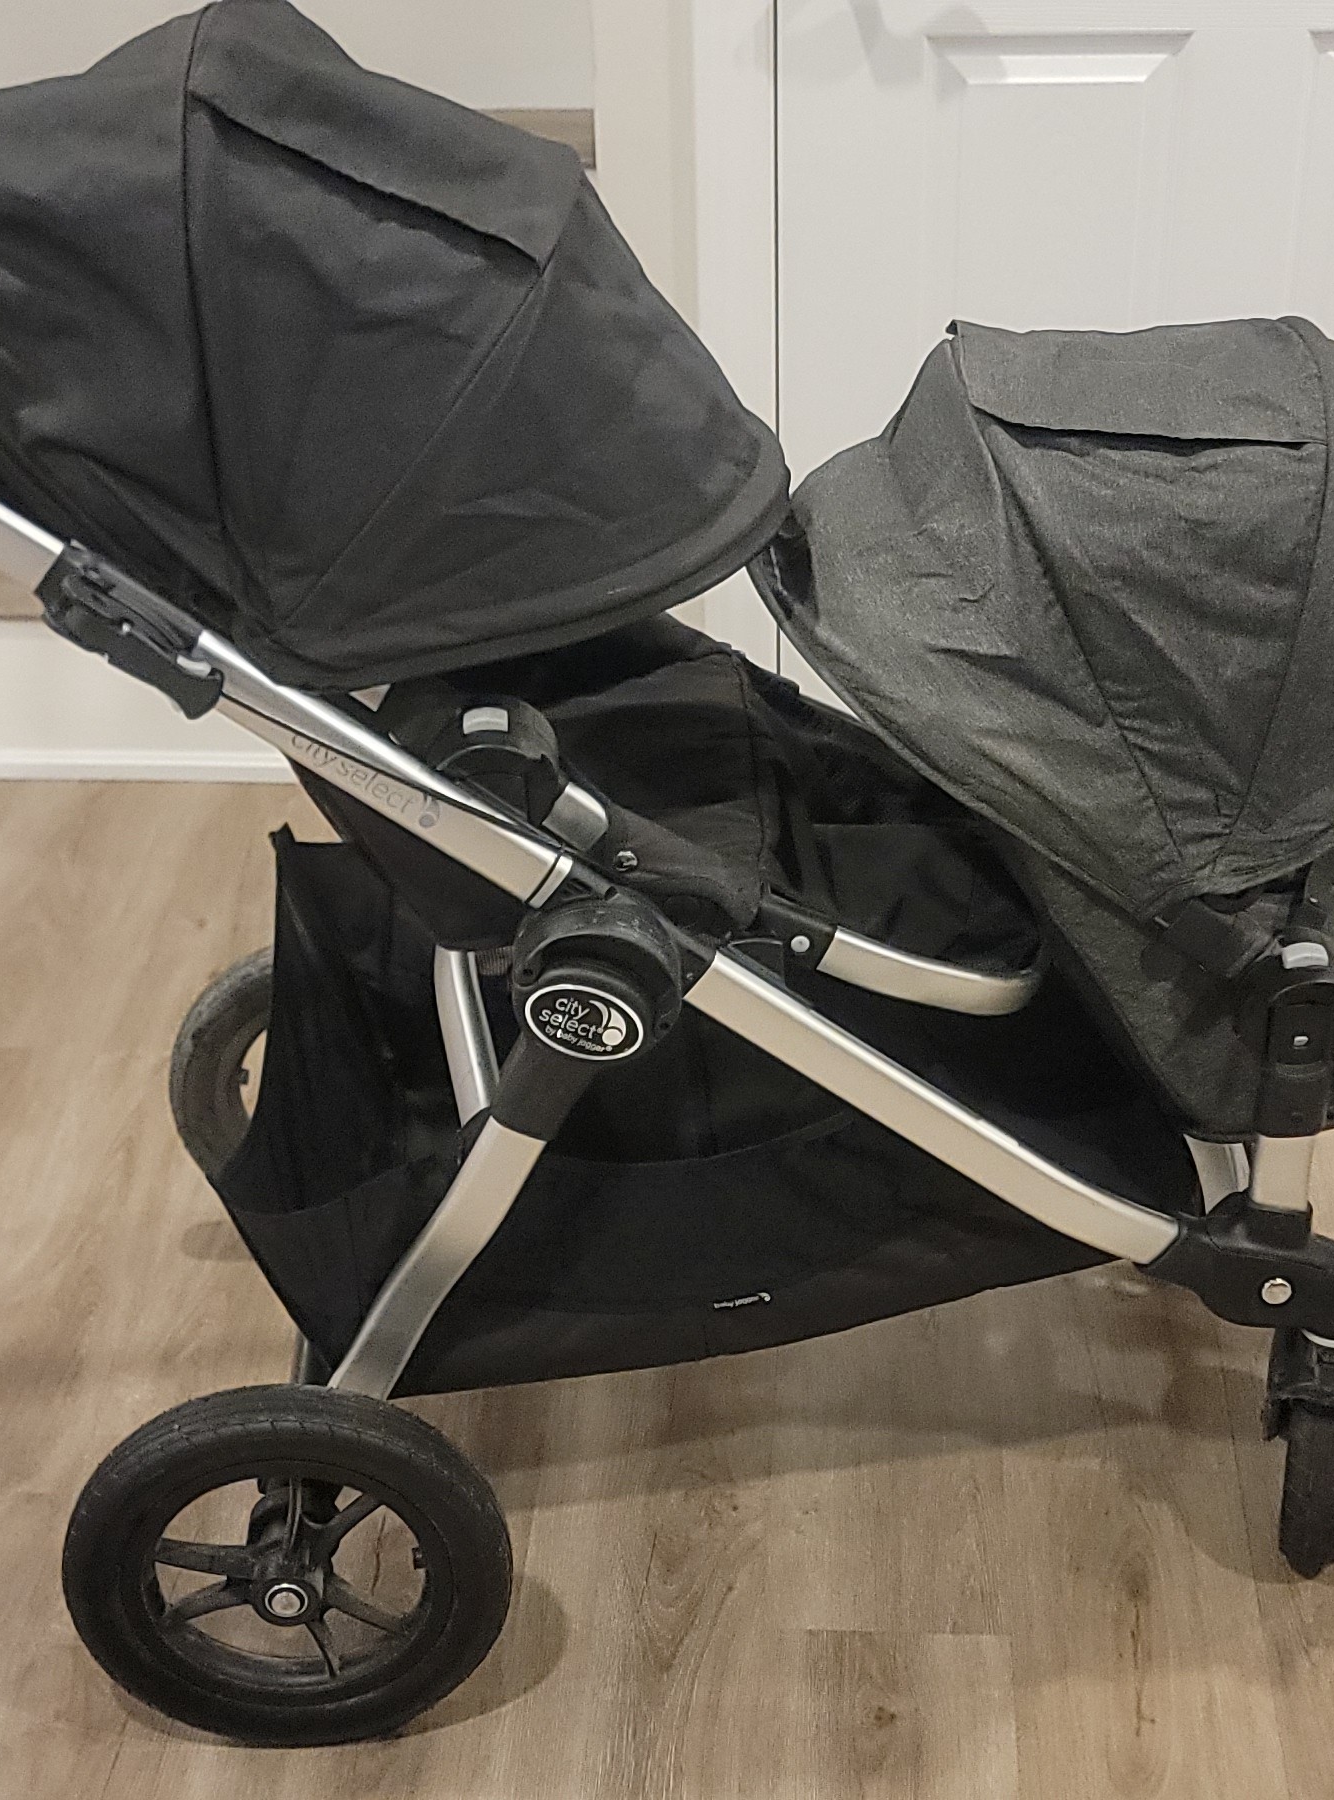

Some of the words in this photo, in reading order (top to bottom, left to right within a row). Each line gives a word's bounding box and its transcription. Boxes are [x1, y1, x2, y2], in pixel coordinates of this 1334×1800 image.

[291, 735, 338, 767] city
[336, 762, 414, 813] select
[539, 1009, 597, 1038] select
[555, 998, 590, 1020] city
